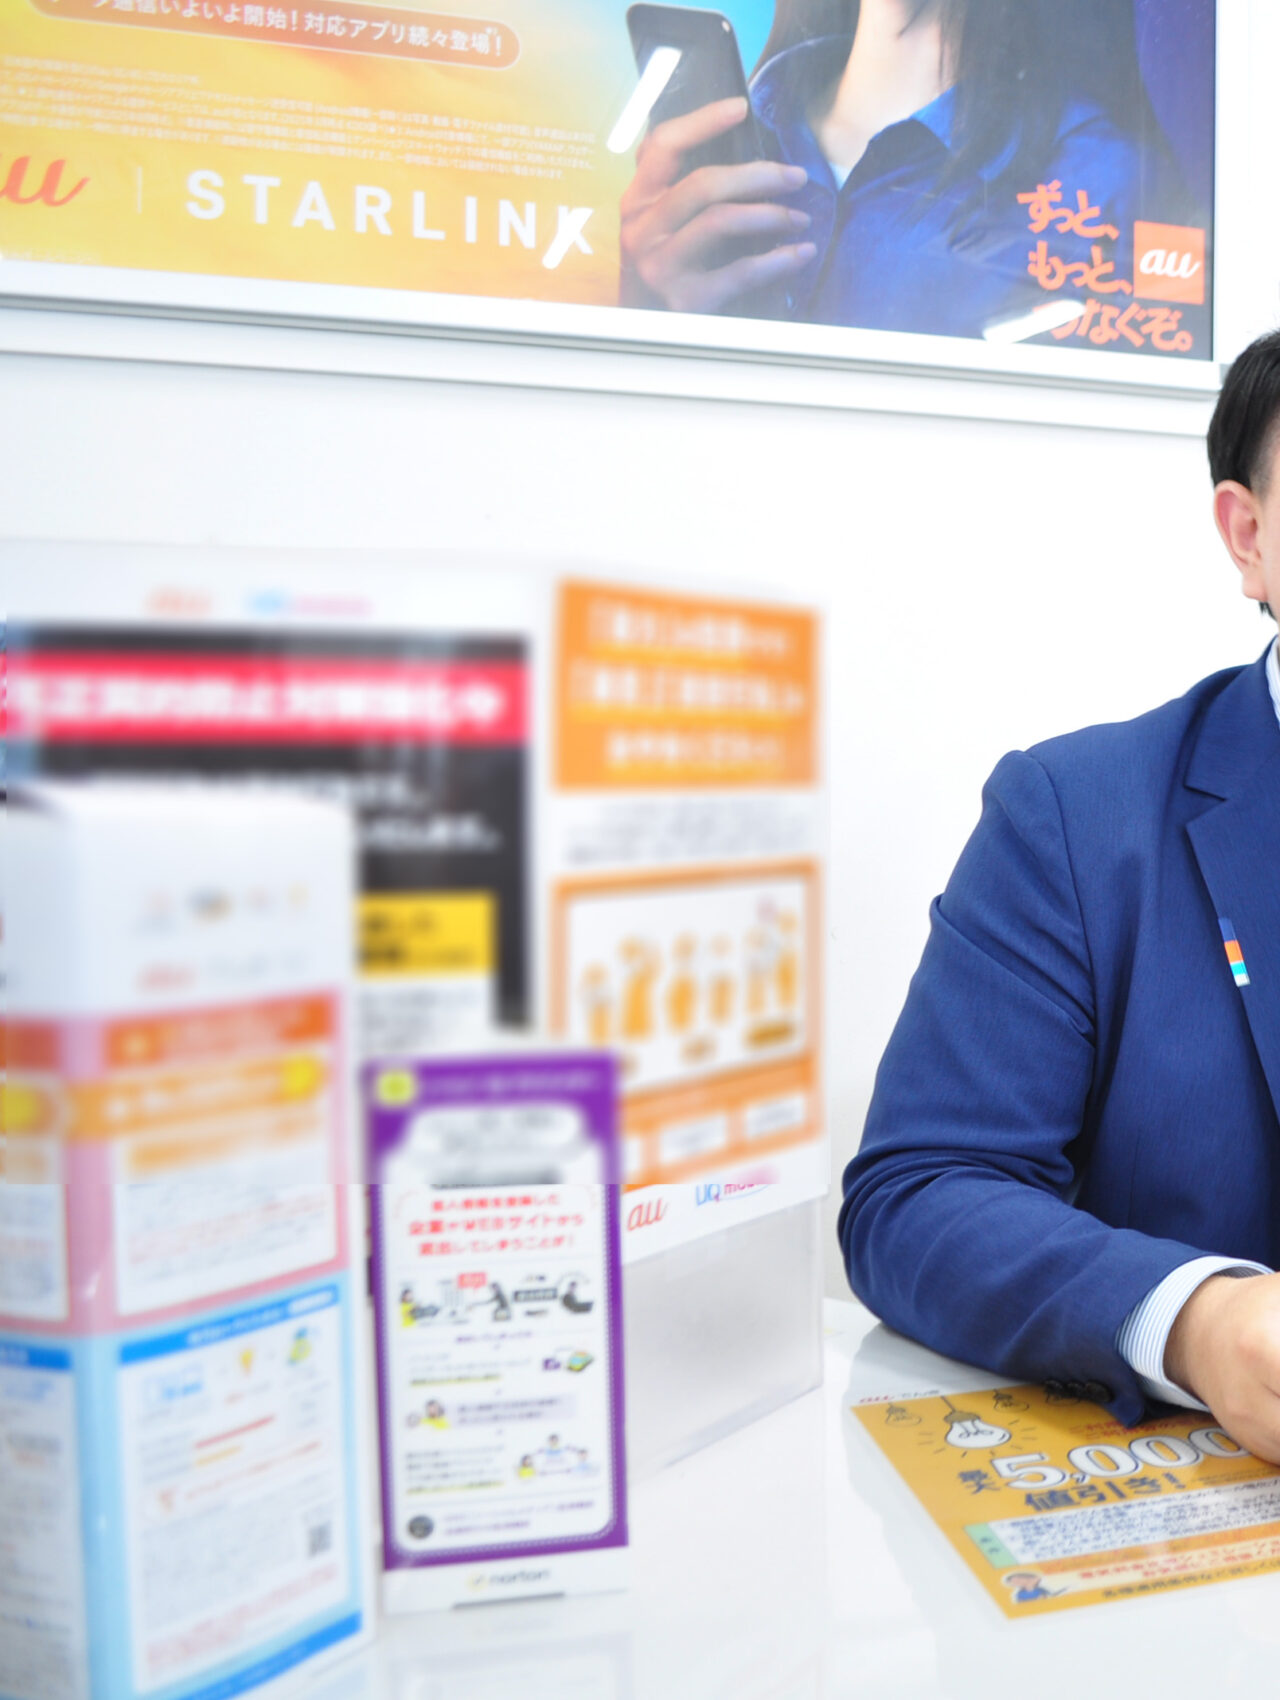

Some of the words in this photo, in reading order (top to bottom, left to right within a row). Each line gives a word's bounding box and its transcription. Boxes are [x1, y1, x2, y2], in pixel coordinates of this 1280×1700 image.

[0, 153, 91, 207] u
[1016, 179, 1120, 240] ずっと、
[1027, 240, 1133, 296] もっと、
[1139, 248, 1202, 279] au
[627, 1197, 669, 1232] au
